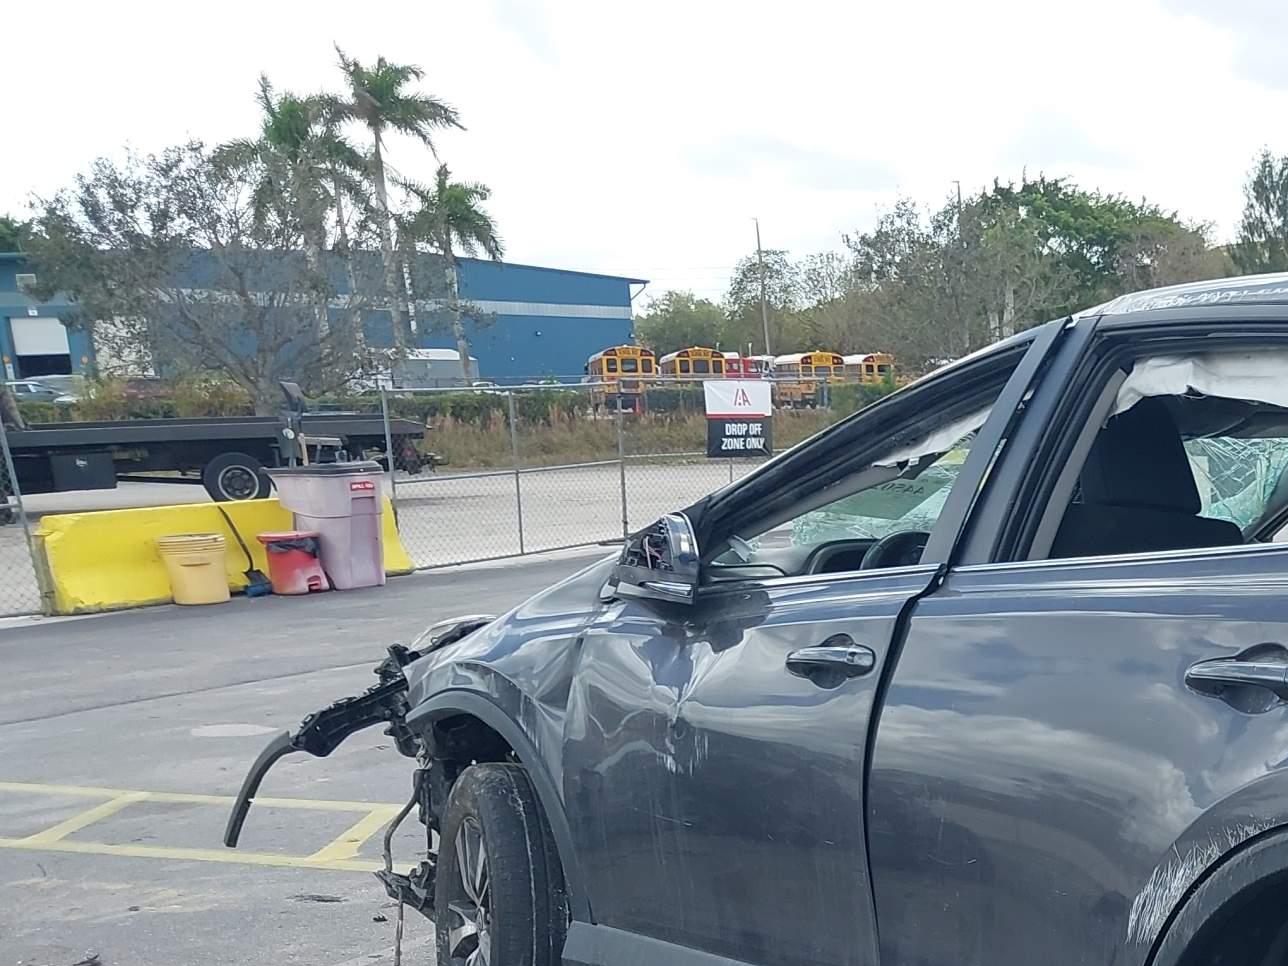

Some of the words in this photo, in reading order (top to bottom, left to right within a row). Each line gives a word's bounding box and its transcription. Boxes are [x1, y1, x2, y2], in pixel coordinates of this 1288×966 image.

[725, 423, 748, 436] DROP
[749, 423, 763, 436] OFF
[721, 437, 745, 450] ZONE
[746, 437, 765, 449] ONLY
